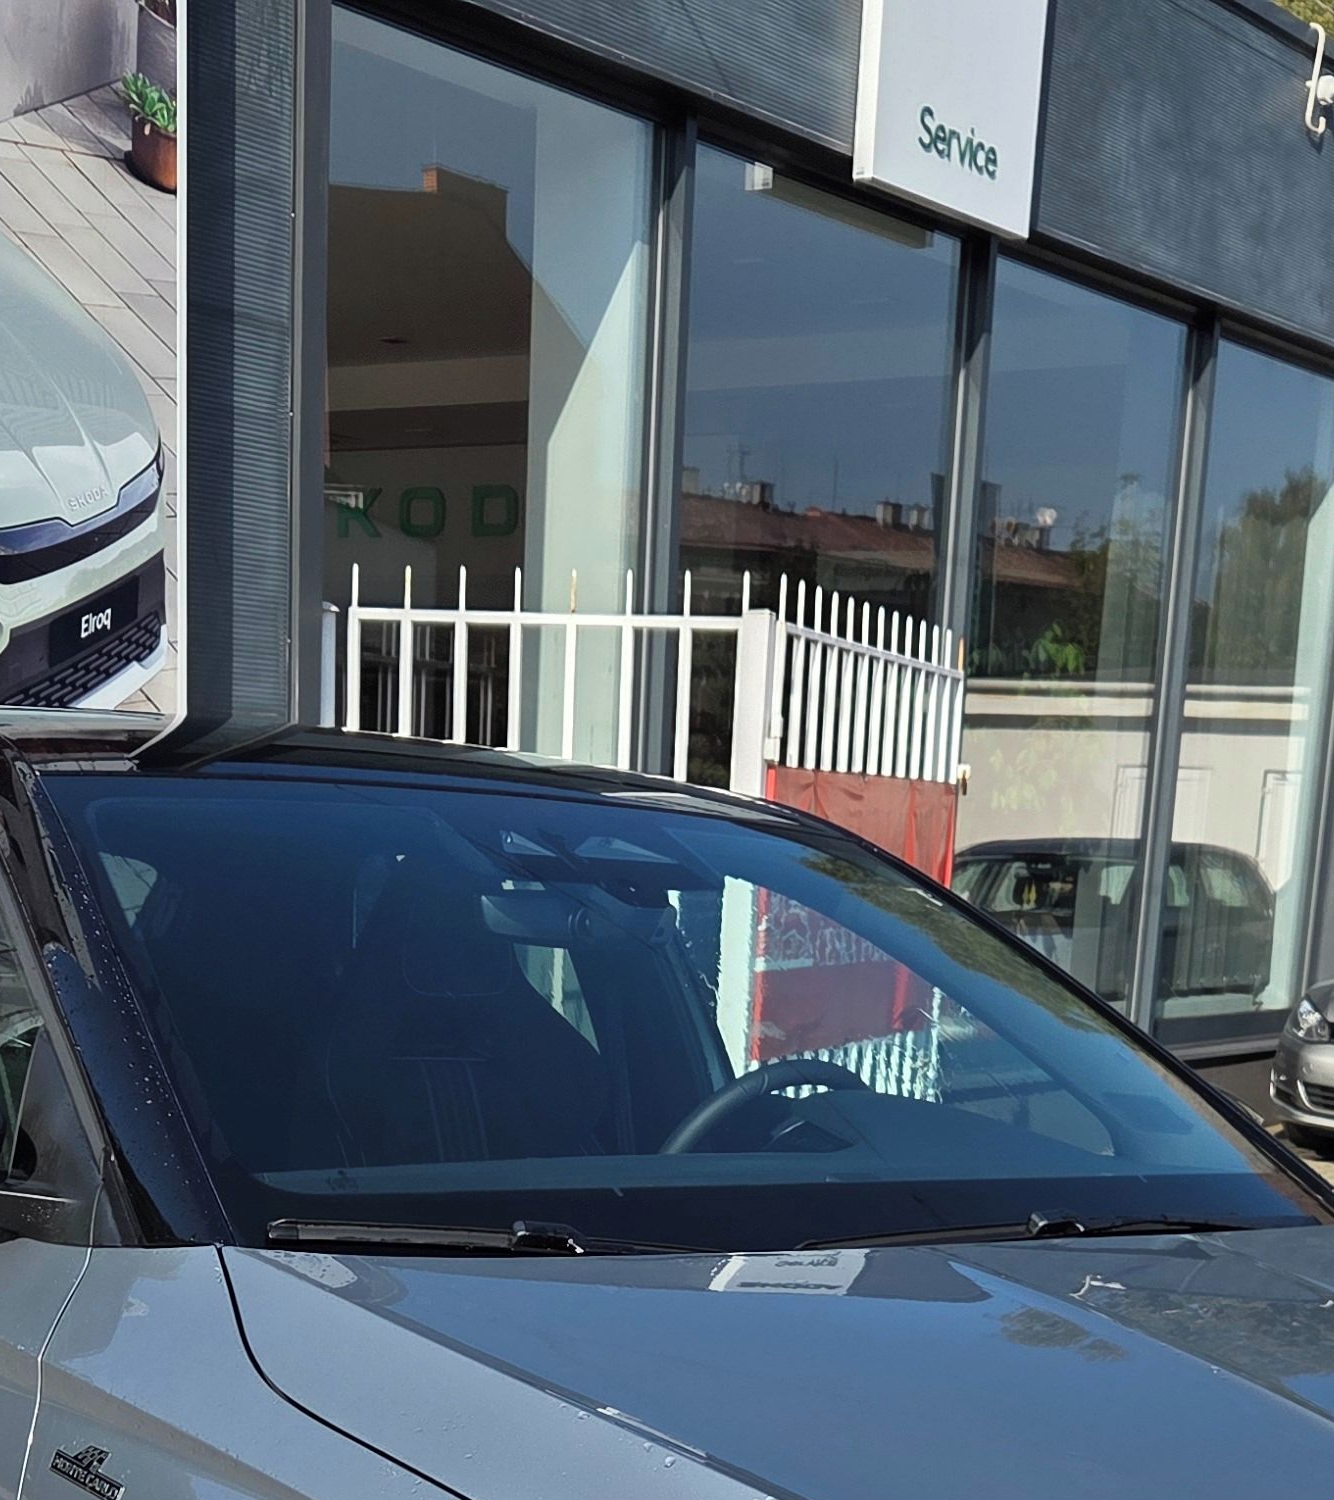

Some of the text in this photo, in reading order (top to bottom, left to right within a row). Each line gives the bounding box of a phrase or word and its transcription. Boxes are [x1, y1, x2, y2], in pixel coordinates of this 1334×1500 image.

[918, 105, 998, 181] Service
[334, 484, 520, 538] KOD
[80, 607, 112, 638] Elroq
